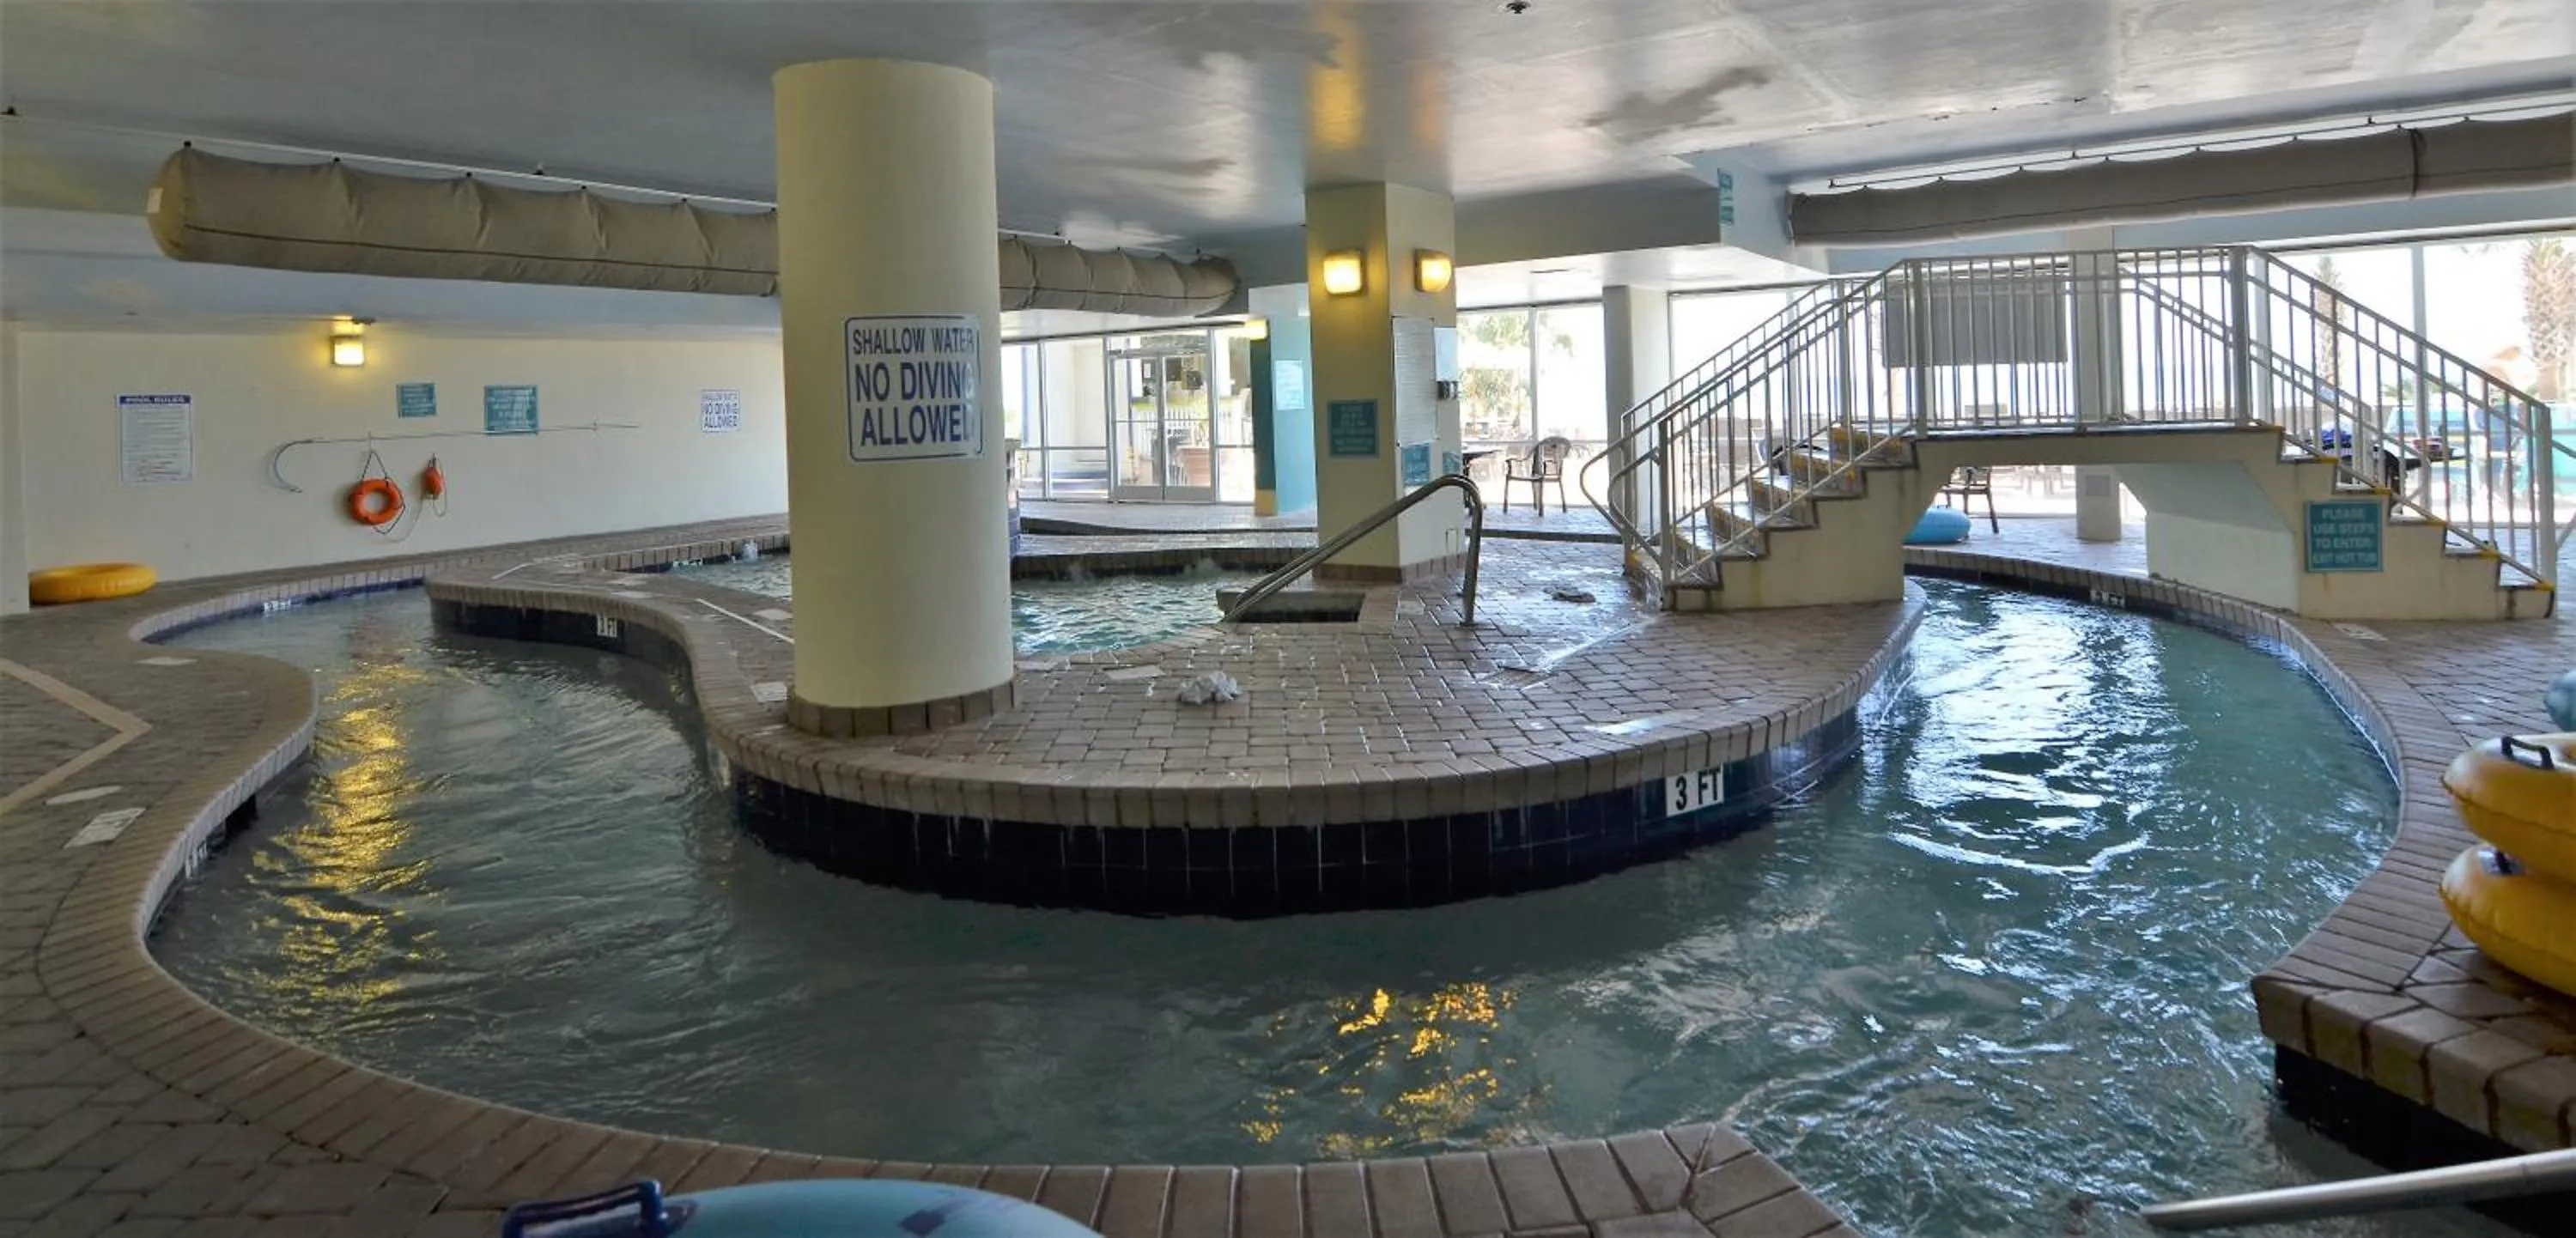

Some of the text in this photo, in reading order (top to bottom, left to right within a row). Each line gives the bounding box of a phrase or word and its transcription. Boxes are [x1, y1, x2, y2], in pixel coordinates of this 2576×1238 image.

[853, 326, 975, 355] SHALLOW WATER
[854, 360, 975, 403] NO DIVING
[2322, 507, 2366, 519] PLEASE
[2313, 523, 2375, 535] USE STEPS
[2315, 537, 2331, 549] TO
[1675, 767, 1722, 811] 3 FT
